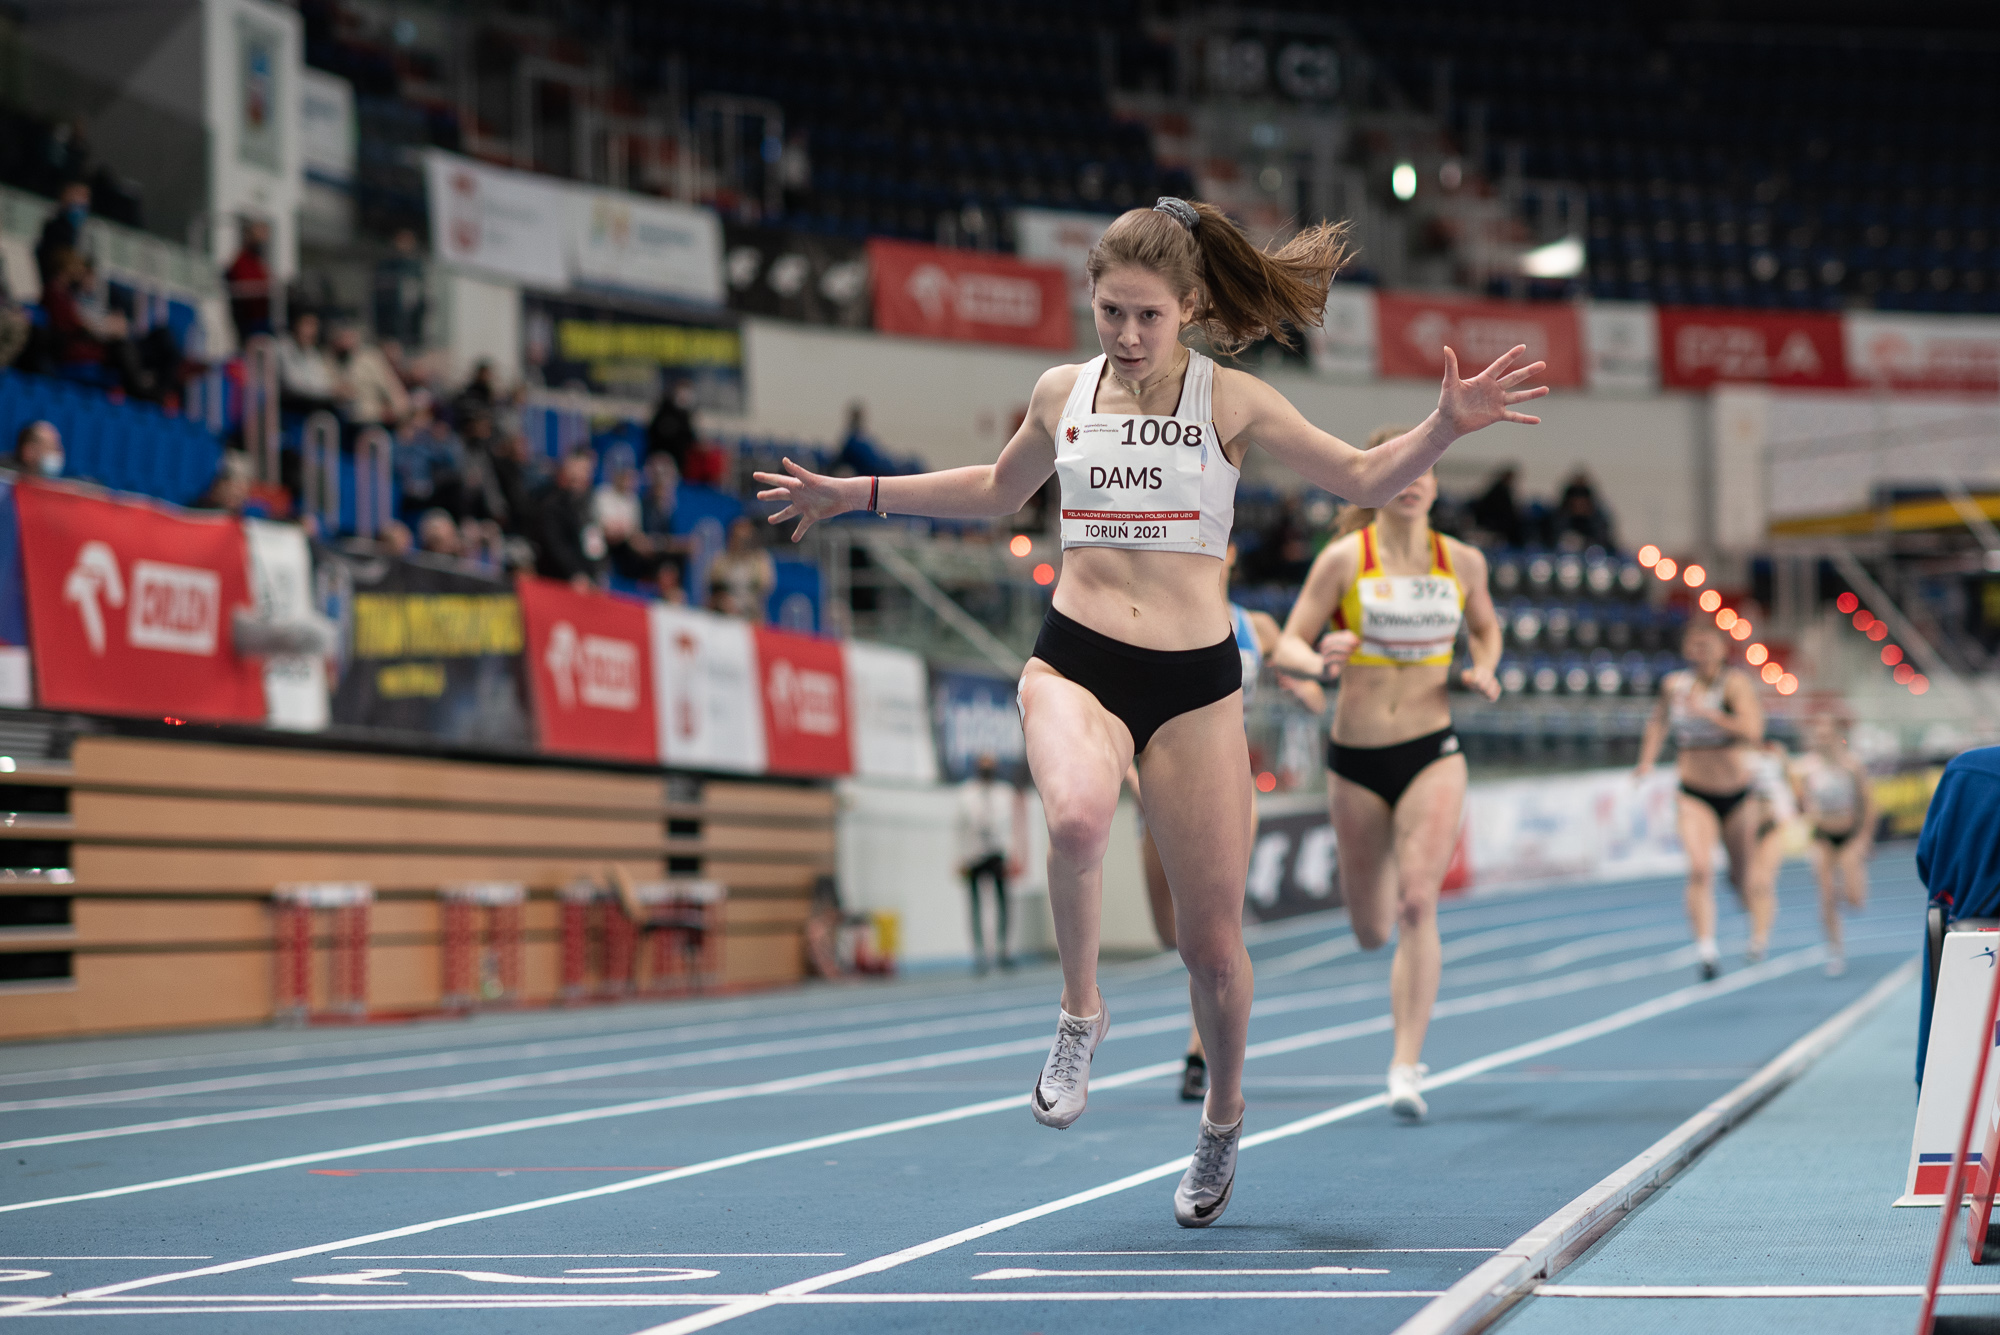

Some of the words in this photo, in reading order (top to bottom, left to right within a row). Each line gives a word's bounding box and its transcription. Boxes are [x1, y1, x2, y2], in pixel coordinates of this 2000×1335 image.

[1121, 419, 1203, 447] 1008
[1090, 466, 1163, 490] DAMS
[1085, 521, 1128, 539] TORUŃ
[1133, 525, 1167, 539] 2021
[1411, 580, 1451, 599] 392
